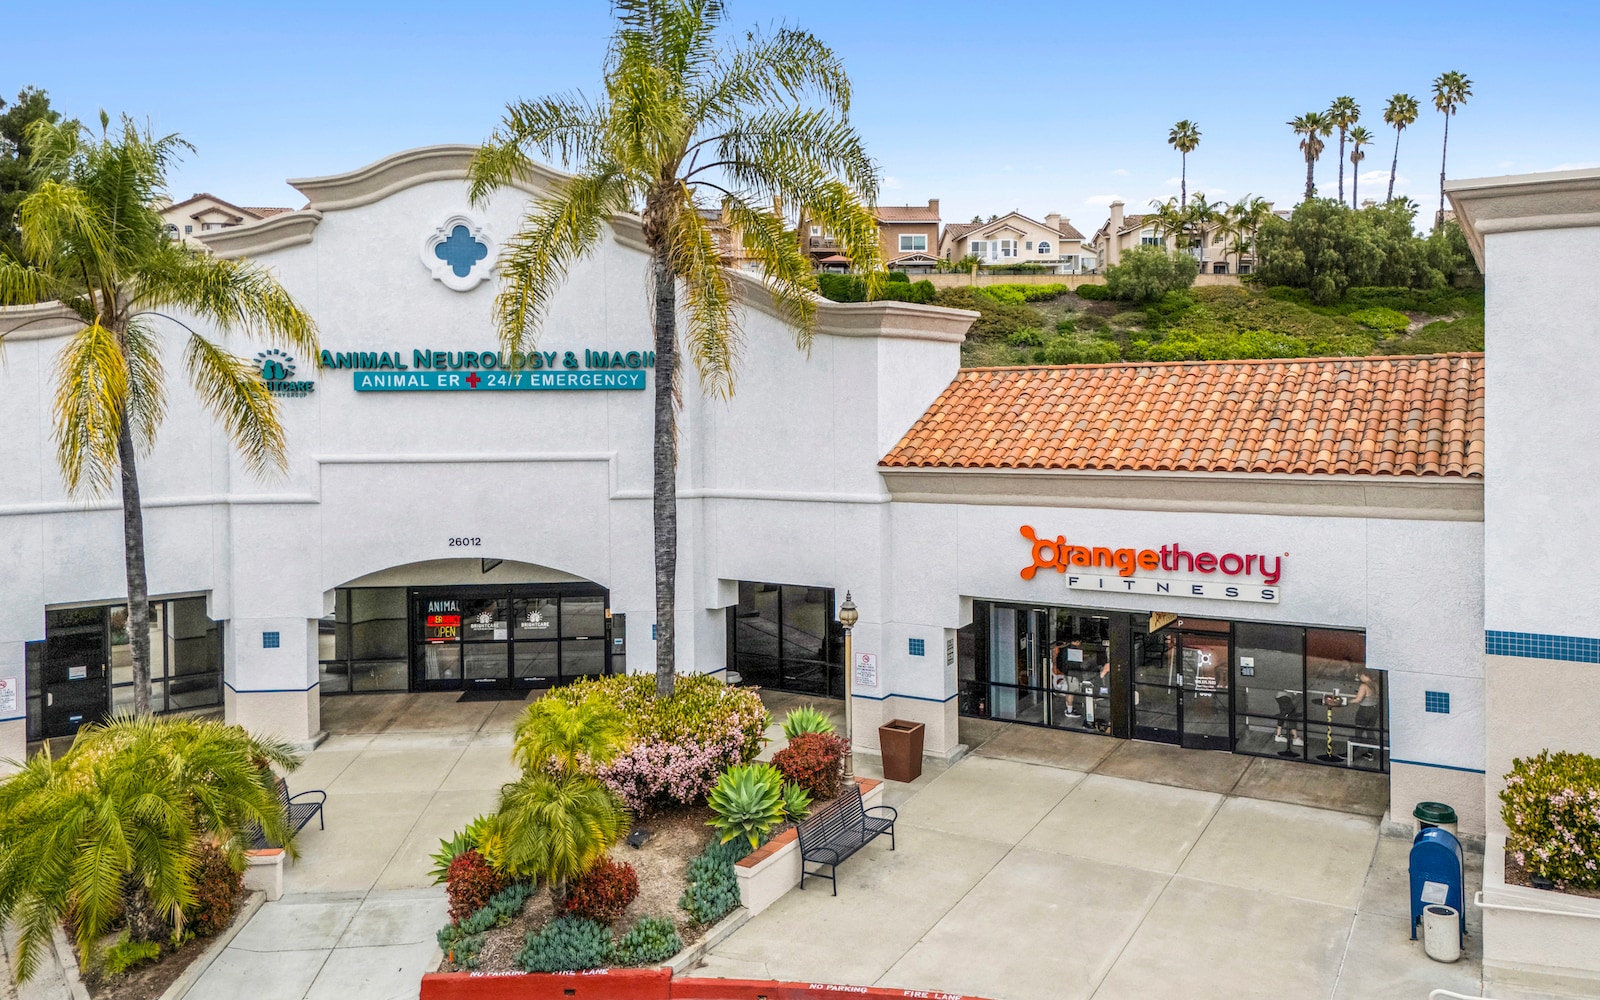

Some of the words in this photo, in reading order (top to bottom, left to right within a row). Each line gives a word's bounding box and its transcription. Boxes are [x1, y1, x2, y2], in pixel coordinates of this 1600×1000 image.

[320, 349, 408, 369] ANIMAL
[414, 349, 557, 369] NEUROLOGY
[563, 351, 579, 368] &
[585, 349, 656, 369] IMAGI
[362, 374, 430, 387] ANIMAL
[437, 374, 460, 387] ER
[487, 374, 523, 387] 24/7
[530, 373, 640, 387] EMERGENCY
[448, 537, 481, 547] 26012
[1068, 577, 1276, 600] FITNESS
[428, 600, 460, 612] ANIMAL
[434, 626, 456, 637] OPEN
[826, 985, 867, 993] PARKING
[903, 990, 929, 999] FIRE
